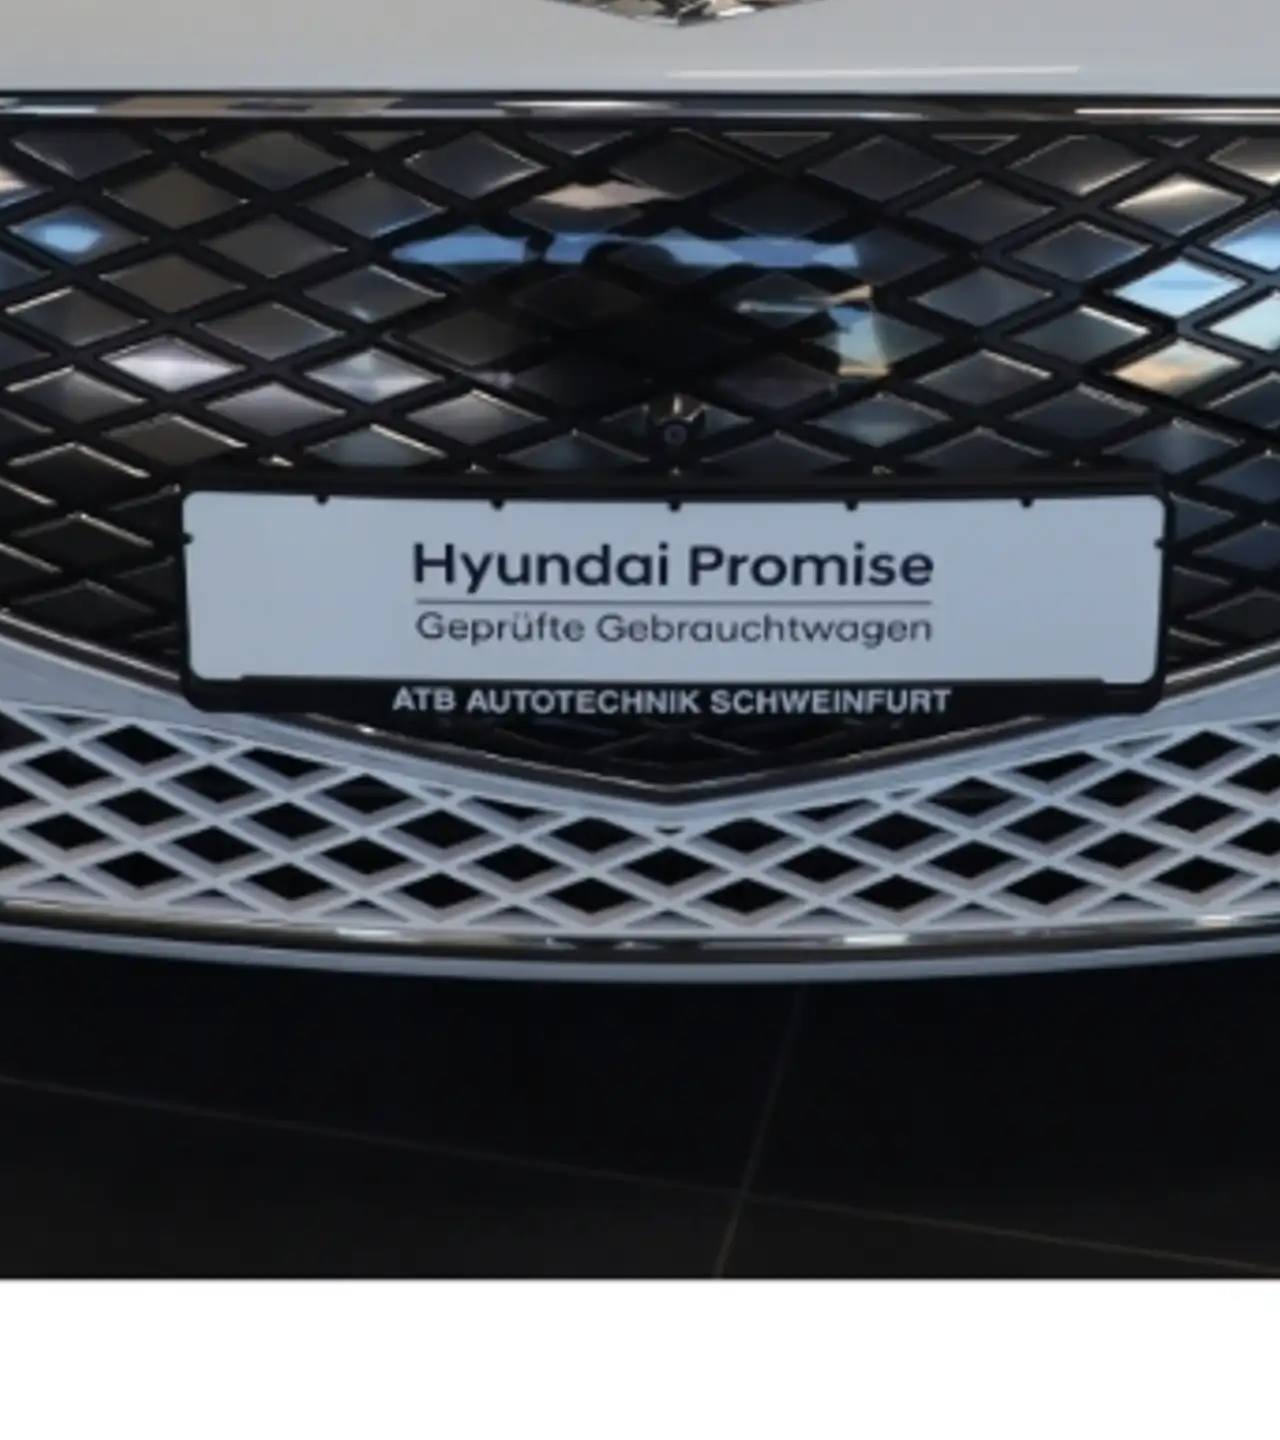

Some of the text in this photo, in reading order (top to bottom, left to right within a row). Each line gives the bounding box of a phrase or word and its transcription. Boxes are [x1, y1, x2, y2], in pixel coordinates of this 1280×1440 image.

[412, 541, 935, 594] Hyundai Promise
[414, 610, 934, 649] Geprüfte Gebrauchtwagen
[391, 686, 953, 715] ATB AUTOTECHNIK SCHWEINFURT
